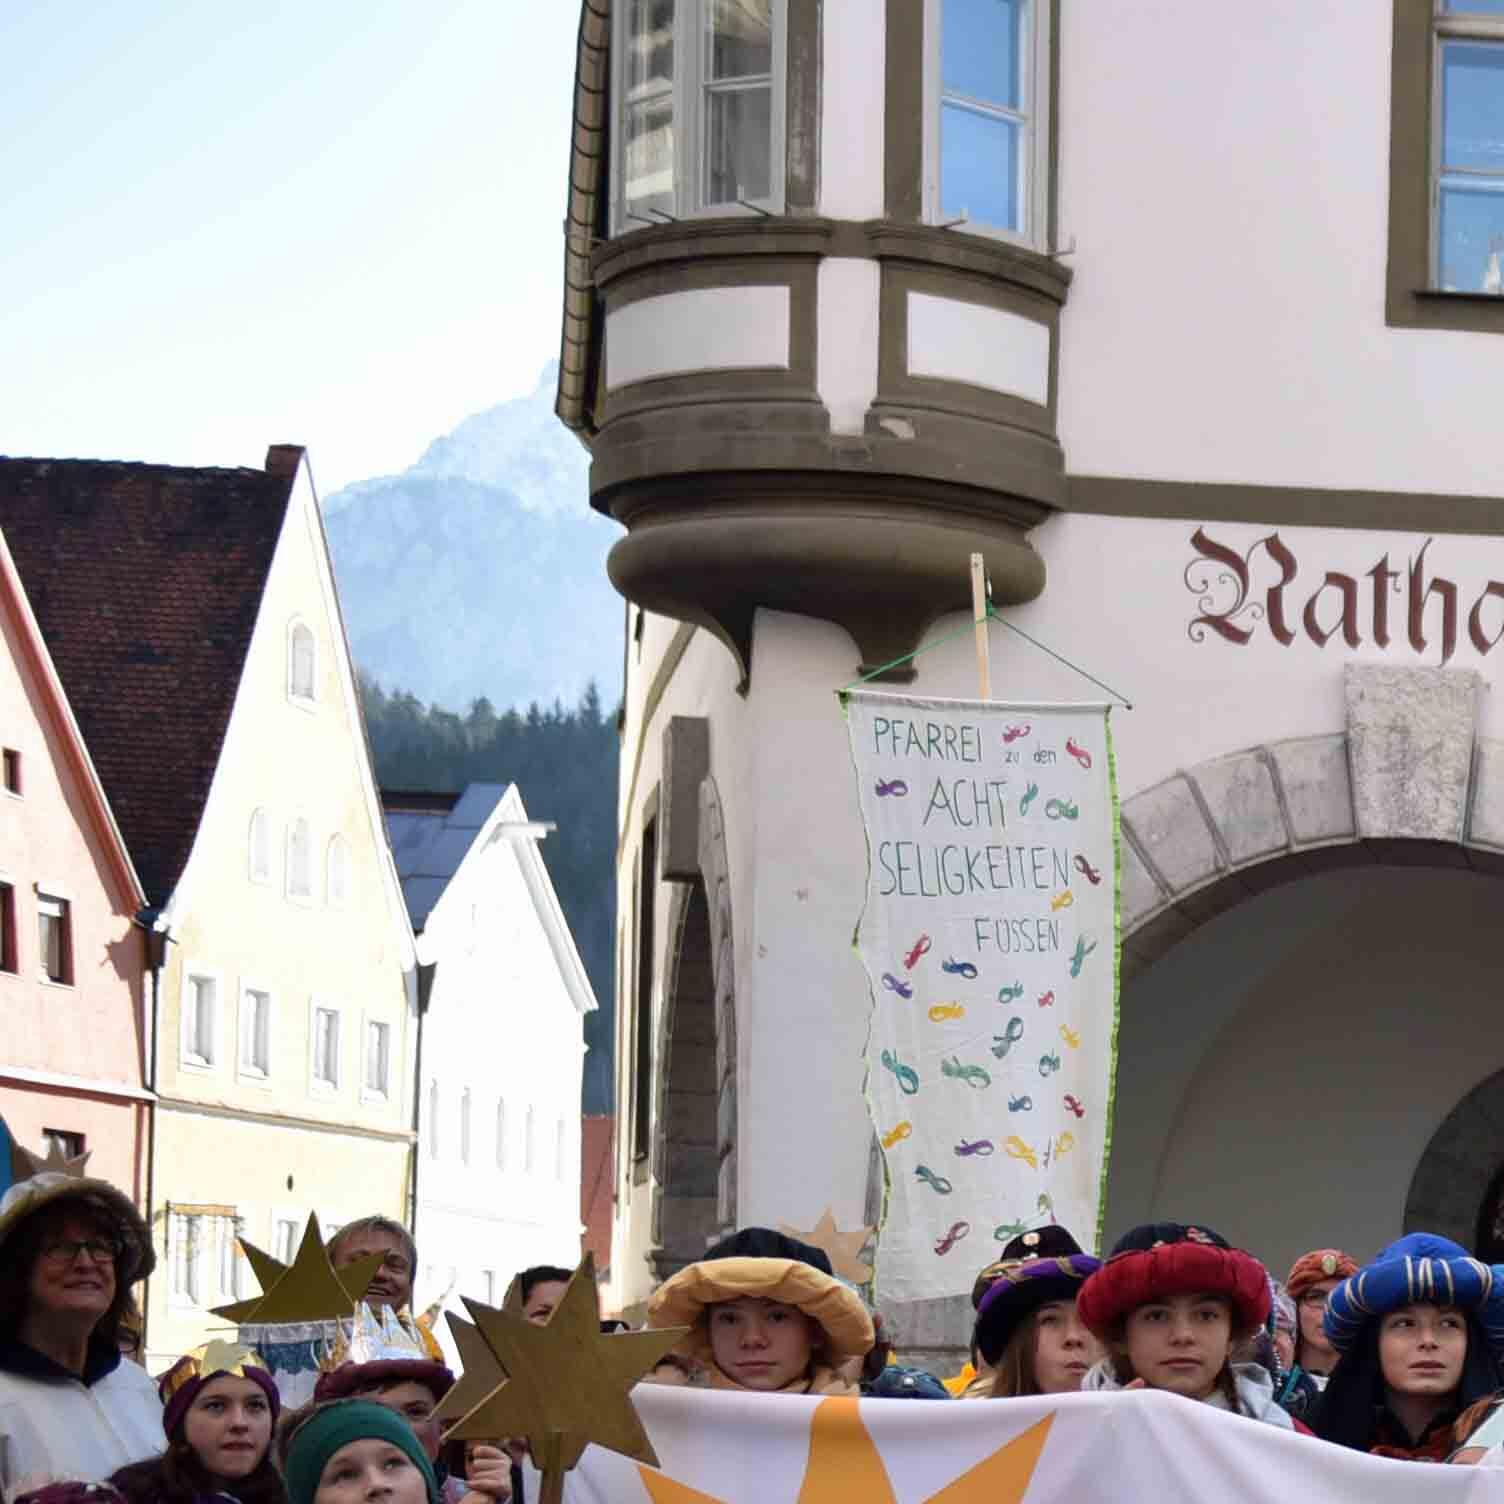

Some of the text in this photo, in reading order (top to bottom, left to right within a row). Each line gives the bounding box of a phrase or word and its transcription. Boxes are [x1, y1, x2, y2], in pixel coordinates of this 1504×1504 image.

[874, 716, 1056, 764] PFARREI zu den
[922, 776, 1008, 827] ACHT
[879, 841, 1069, 897] SELIGKEITEN
